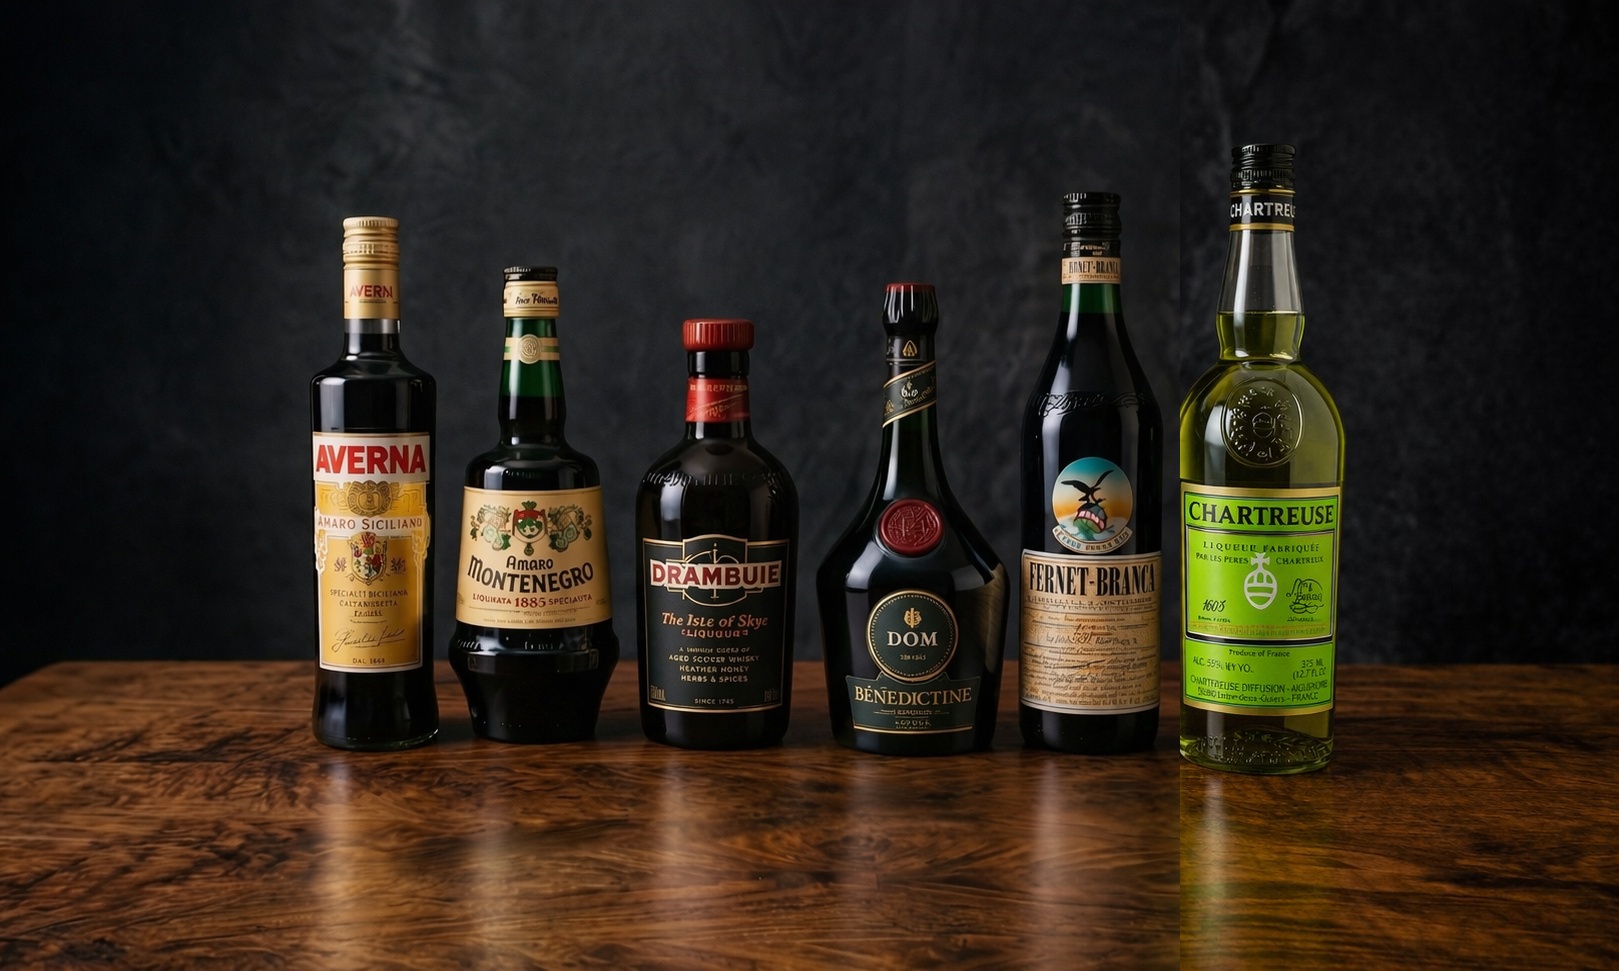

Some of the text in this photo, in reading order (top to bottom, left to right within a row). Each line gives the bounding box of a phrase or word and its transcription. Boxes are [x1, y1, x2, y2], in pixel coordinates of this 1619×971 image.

[1230, 202, 1297, 218] CHARTREU
[316, 445, 427, 474] AVERNA
[1189, 502, 1335, 526] CHARTREUSE
[318, 517, 422, 530] AMARO SICILIANO
[468, 555, 594, 593] MONTENEGRO
[653, 563, 780, 586] DRAMBUIE
[515, 597, 546, 608] 1885
[662, 612, 684, 626] The
[719, 615, 736, 628] of
[738, 614, 768, 630] Skye
[887, 631, 938, 647] DOM
[729, 654, 761, 663] WHISKY
[719, 675, 748, 683] SPICES
